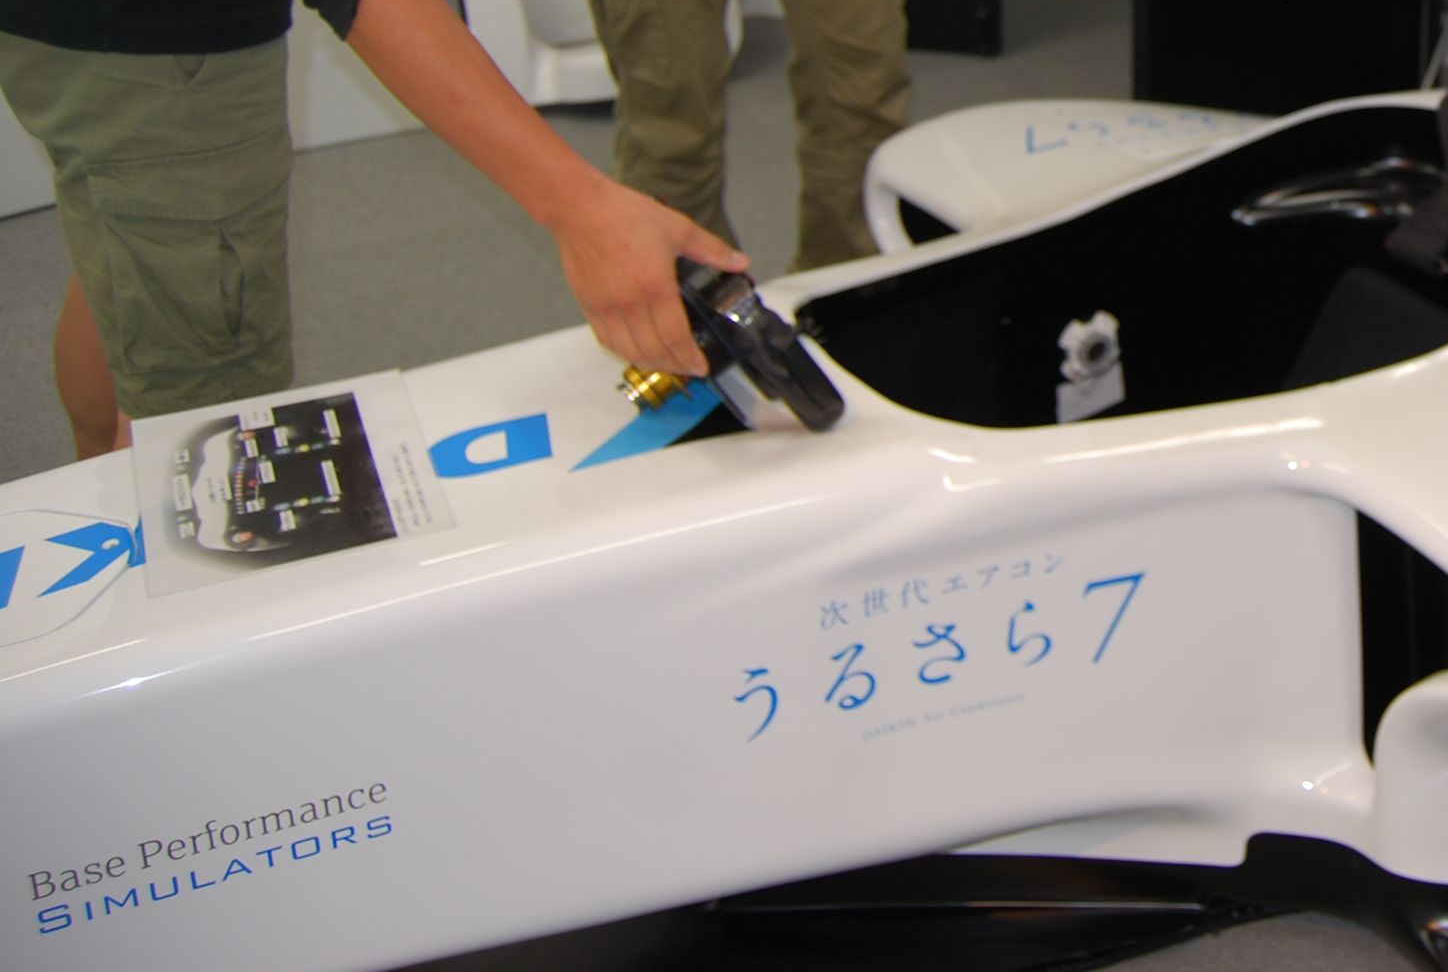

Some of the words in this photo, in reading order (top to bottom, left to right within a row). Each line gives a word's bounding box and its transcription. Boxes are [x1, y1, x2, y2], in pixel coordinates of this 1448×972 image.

[734, 571, 1146, 742] うるさら7
[28, 855, 127, 901] Base
[137, 782, 388, 870] Performance
[37, 815, 393, 935] SIMULATORS
